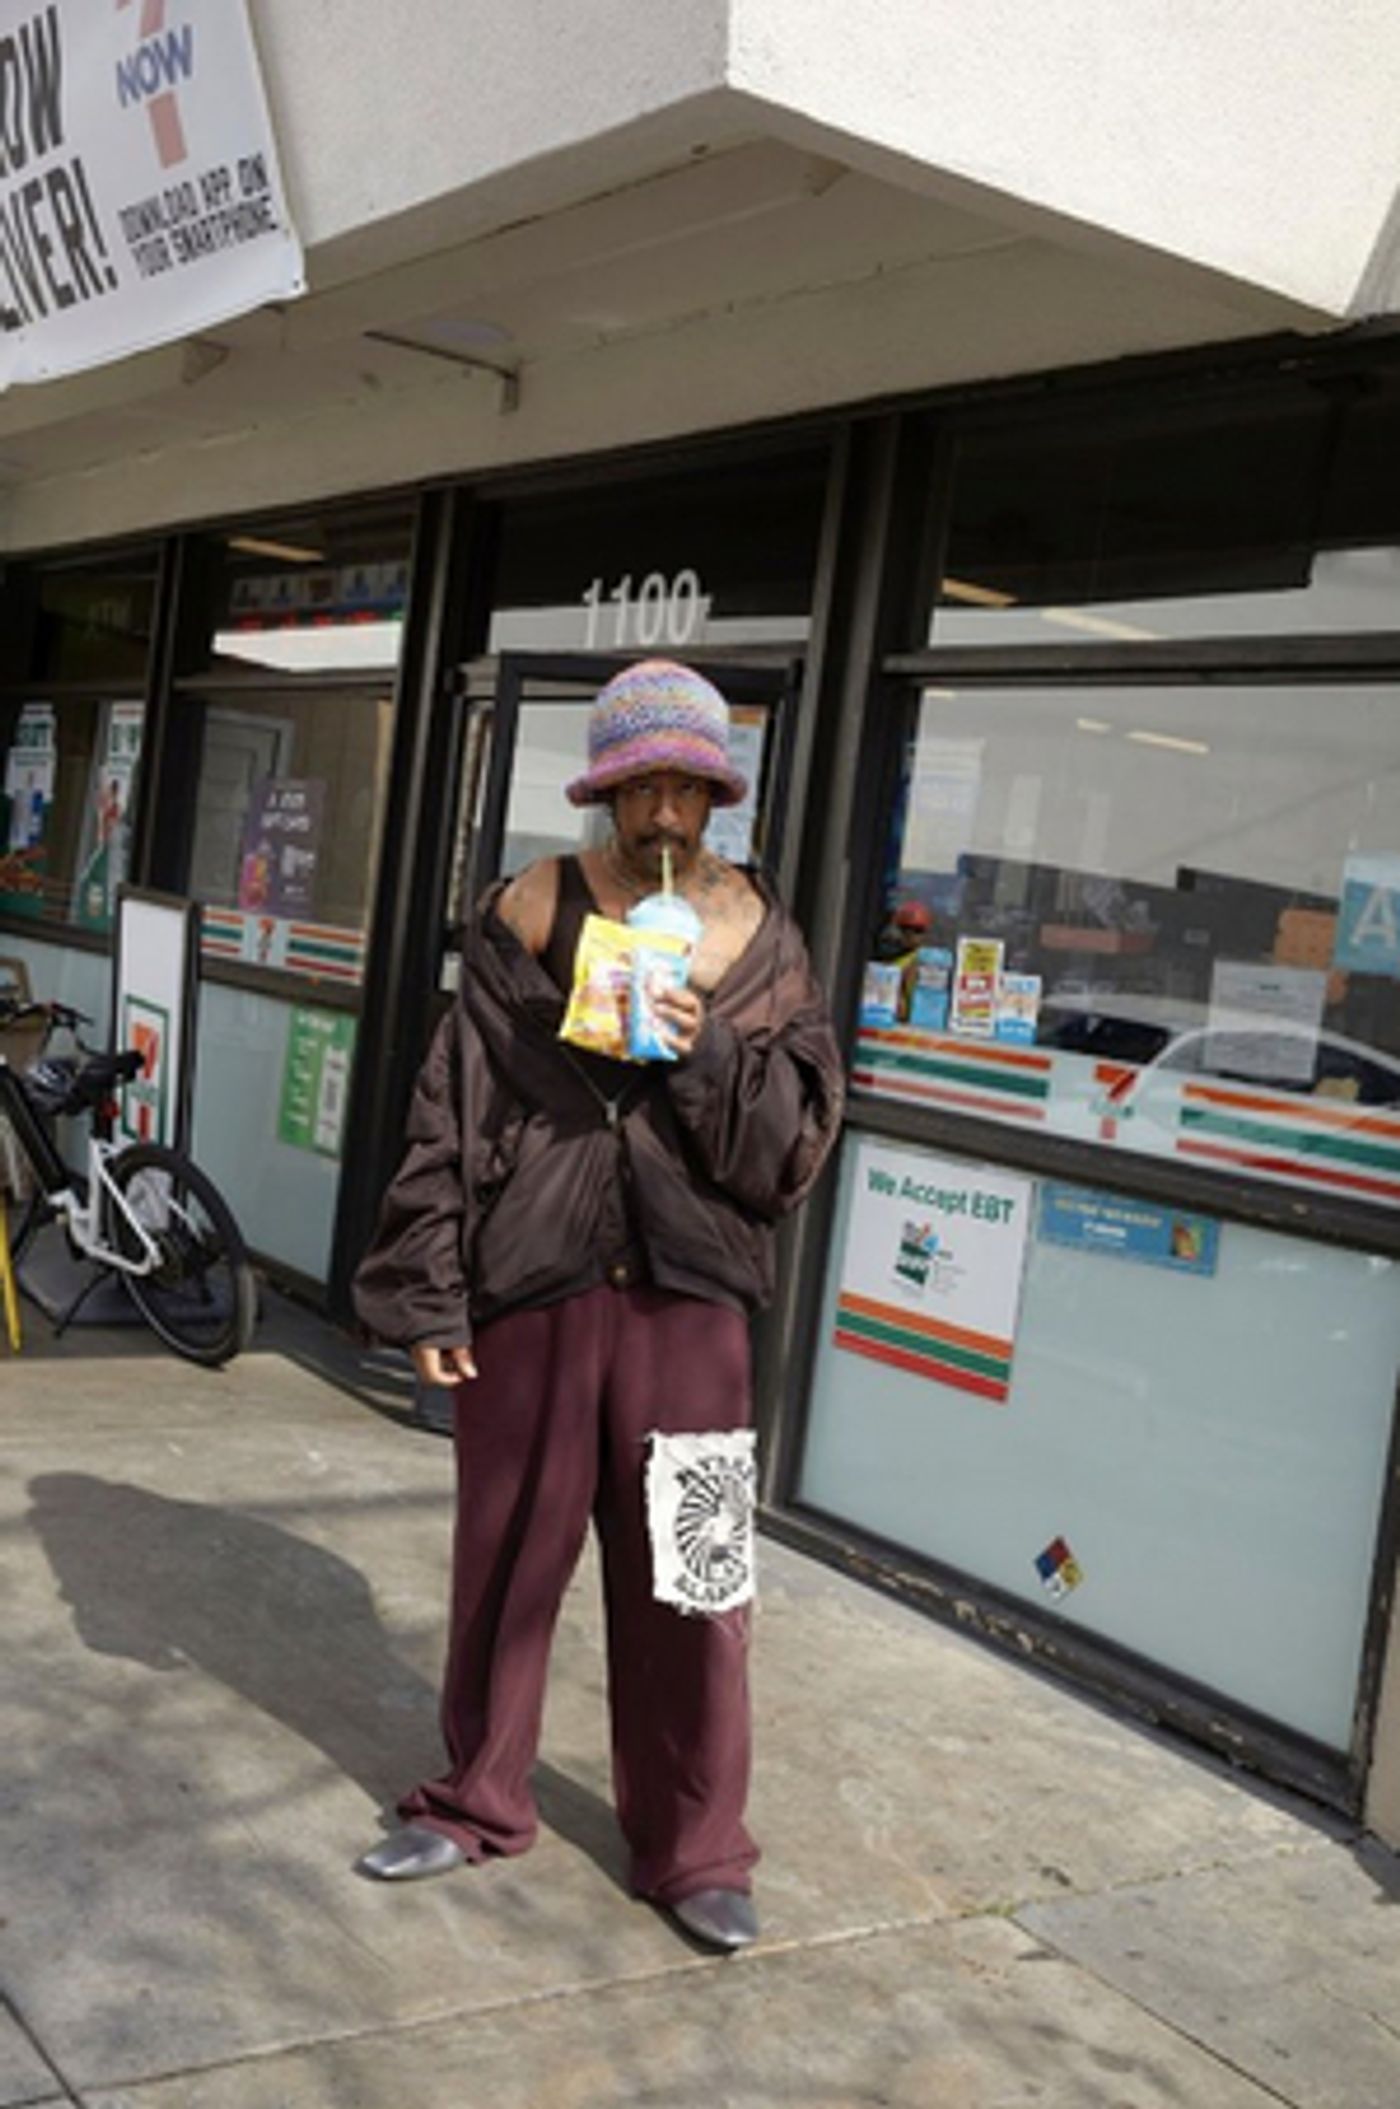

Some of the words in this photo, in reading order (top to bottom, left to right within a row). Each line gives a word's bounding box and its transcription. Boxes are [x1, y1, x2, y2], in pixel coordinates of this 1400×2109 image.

[0, 4, 63, 178] OW
[116, 24, 194, 108] NOW
[199, 165, 231, 211] APP
[238, 152, 268, 198] ON
[0, 157, 118, 333] IVER!
[131, 236, 173, 280] YOUR
[582, 569, 698, 649] 1100
[1350, 882, 1400, 950] A
[868, 1167, 897, 1196] We
[900, 1175, 967, 1216] Accept
[970, 1190, 1015, 1225] EBT
